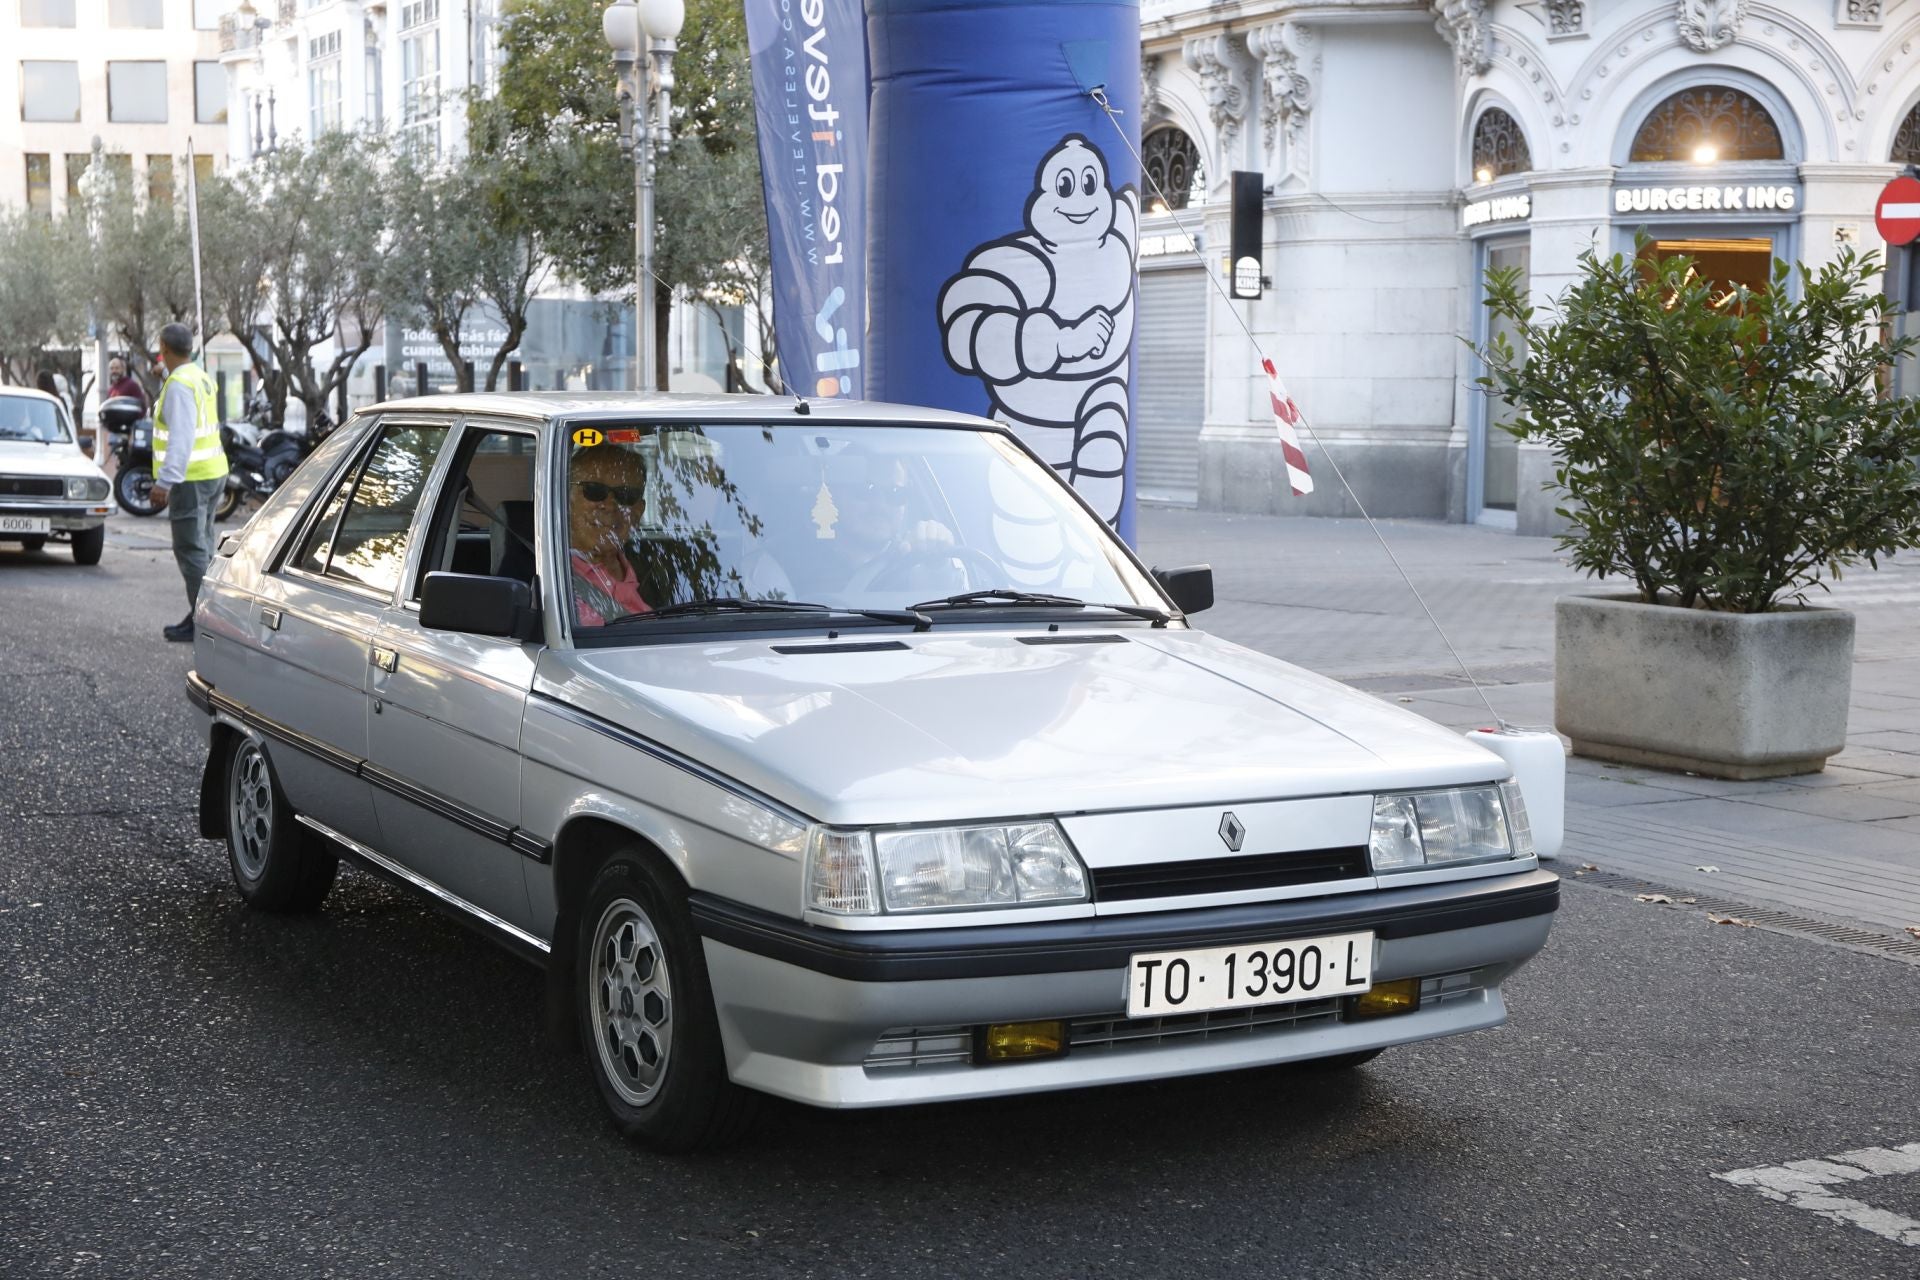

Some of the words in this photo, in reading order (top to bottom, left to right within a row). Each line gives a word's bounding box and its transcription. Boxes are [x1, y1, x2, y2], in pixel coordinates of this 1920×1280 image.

[1615, 187, 1721, 212] BURGER
[1236, 277, 1260, 288] KING
[402, 345, 443, 356] cuand
[580, 431, 596, 444] H
[3, 518, 33, 529] 6006
